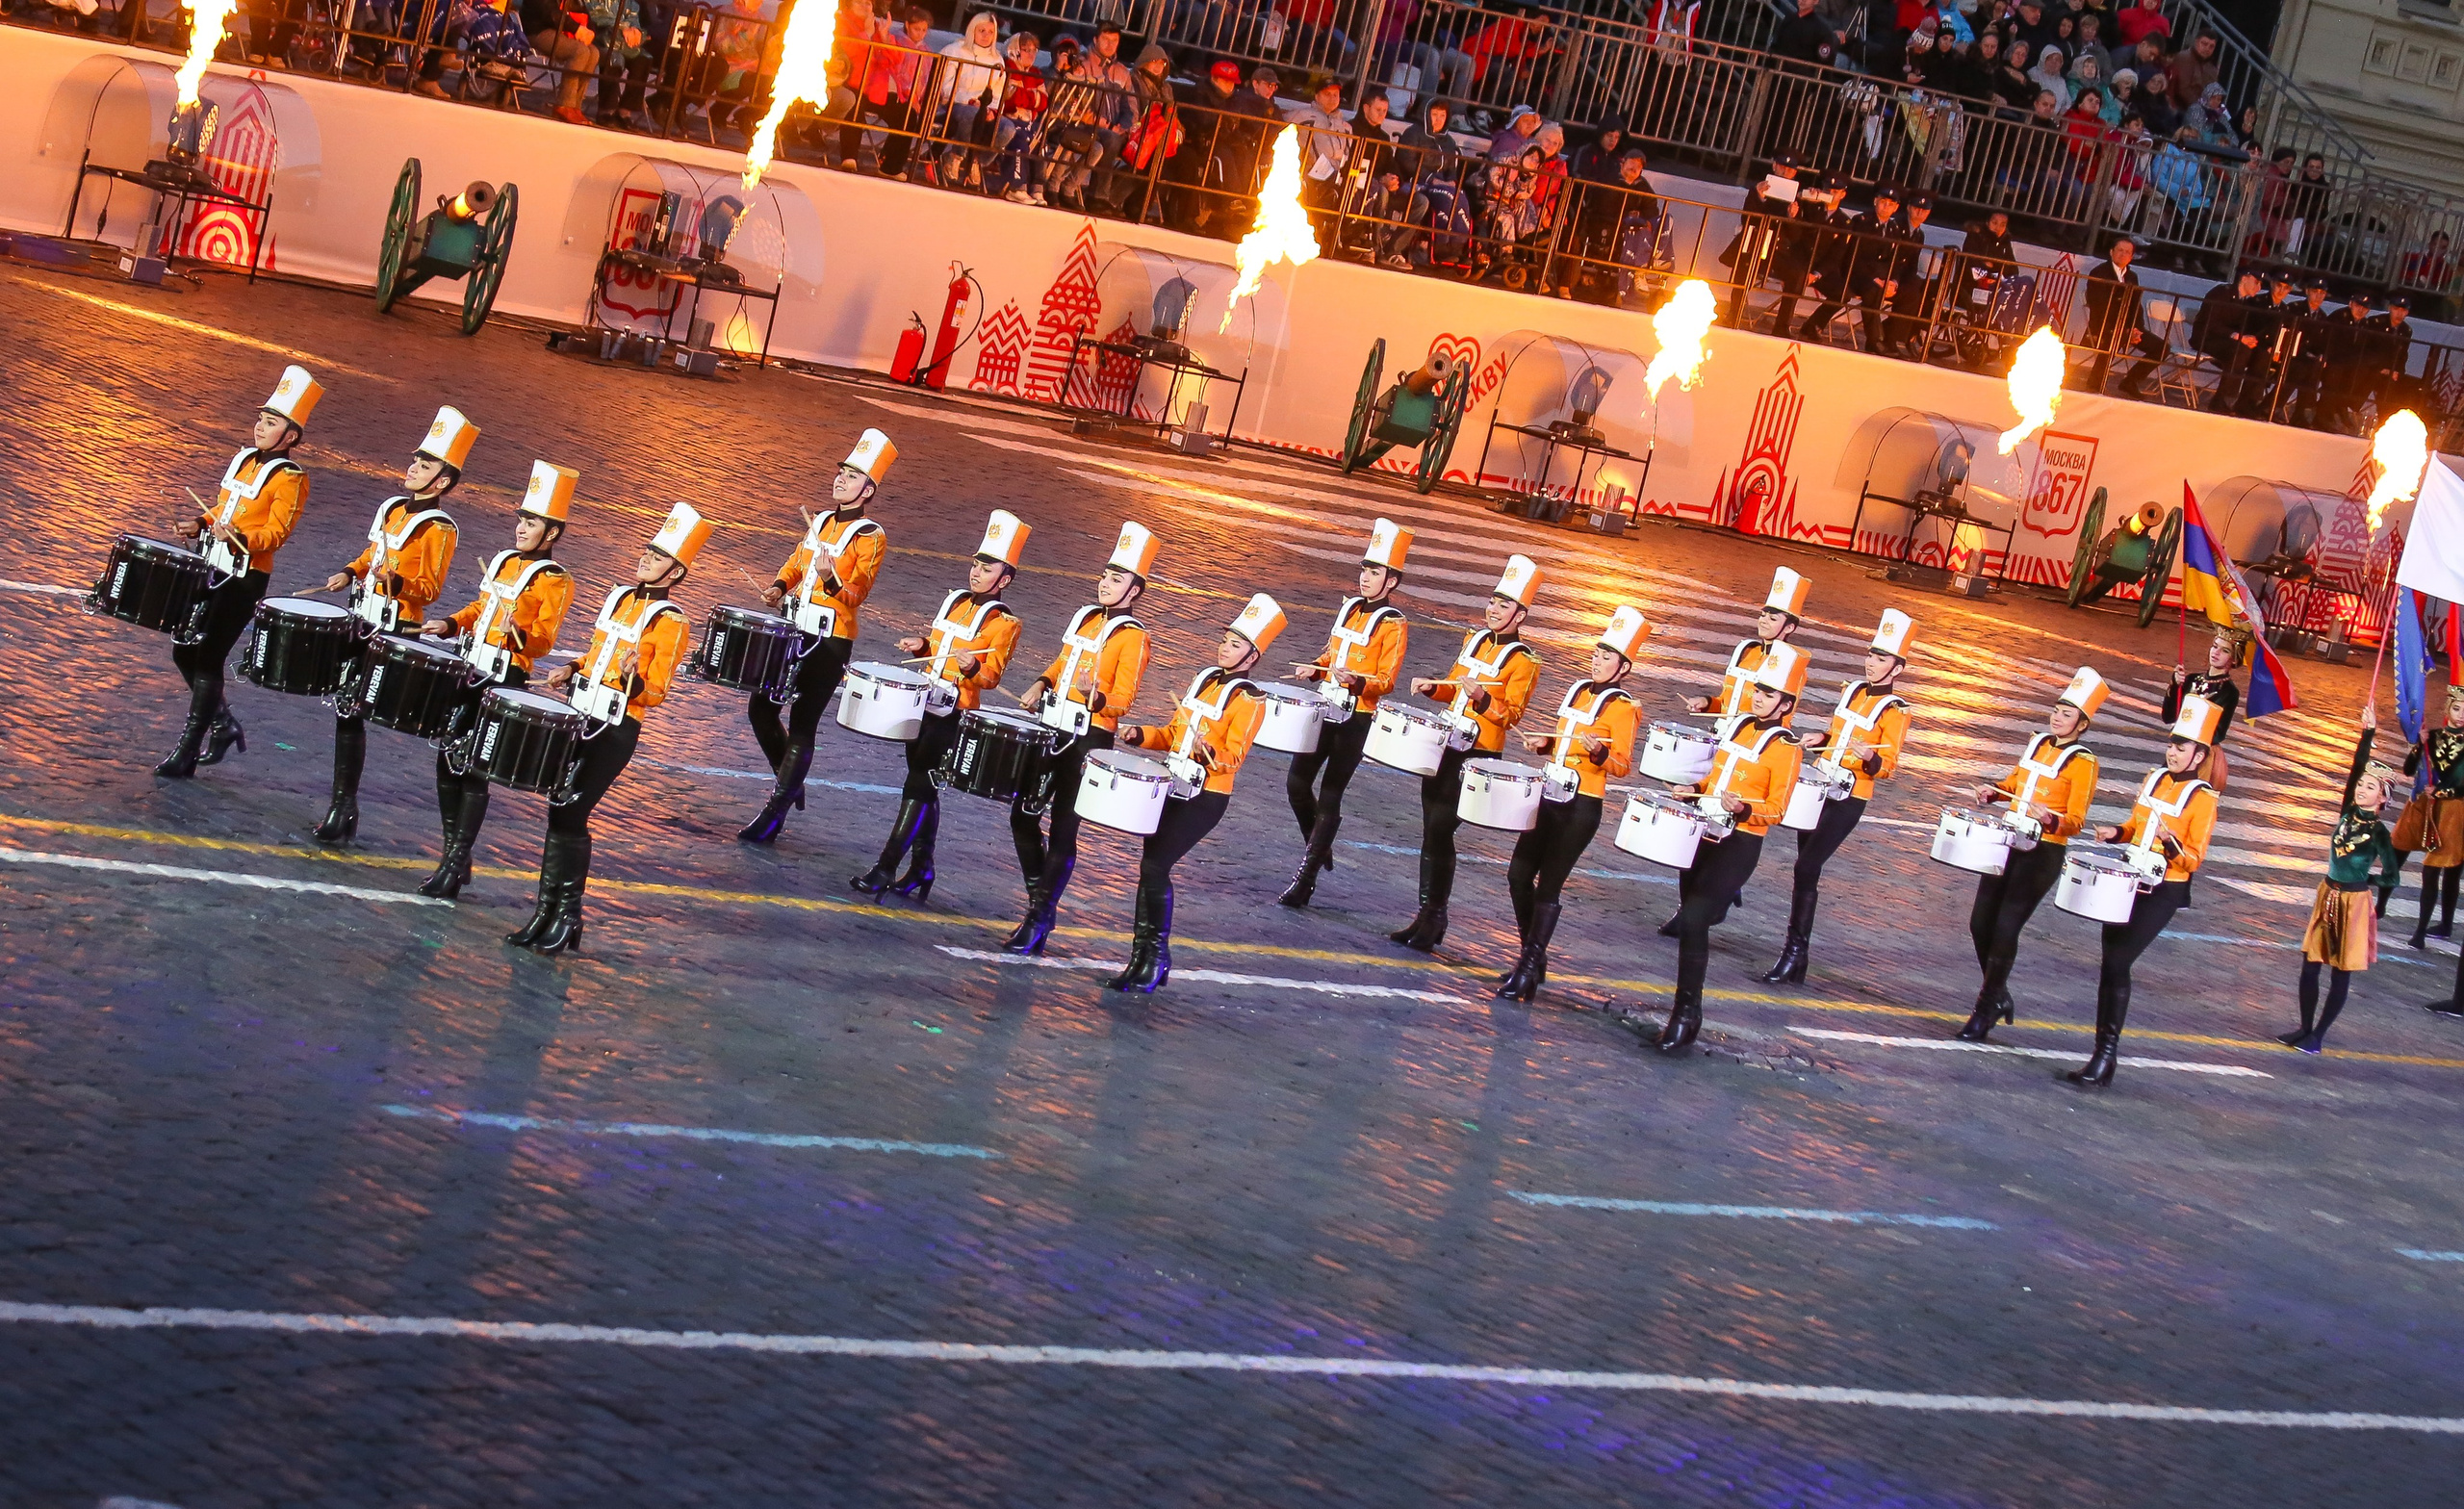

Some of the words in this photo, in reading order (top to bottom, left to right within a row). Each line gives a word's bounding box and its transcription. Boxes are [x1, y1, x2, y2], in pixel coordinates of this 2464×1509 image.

[2043, 448, 2087, 471] МОСКВА
[2032, 470, 2084, 515] 867
[110, 561, 128, 599] YEREVAN
[256, 629, 269, 668] YEREVAN
[709, 631, 726, 667] YEREVAN
[365, 664, 385, 703] YEREVAN
[479, 721, 500, 761] YEREVAN
[960, 738, 978, 776] YEREVAN
